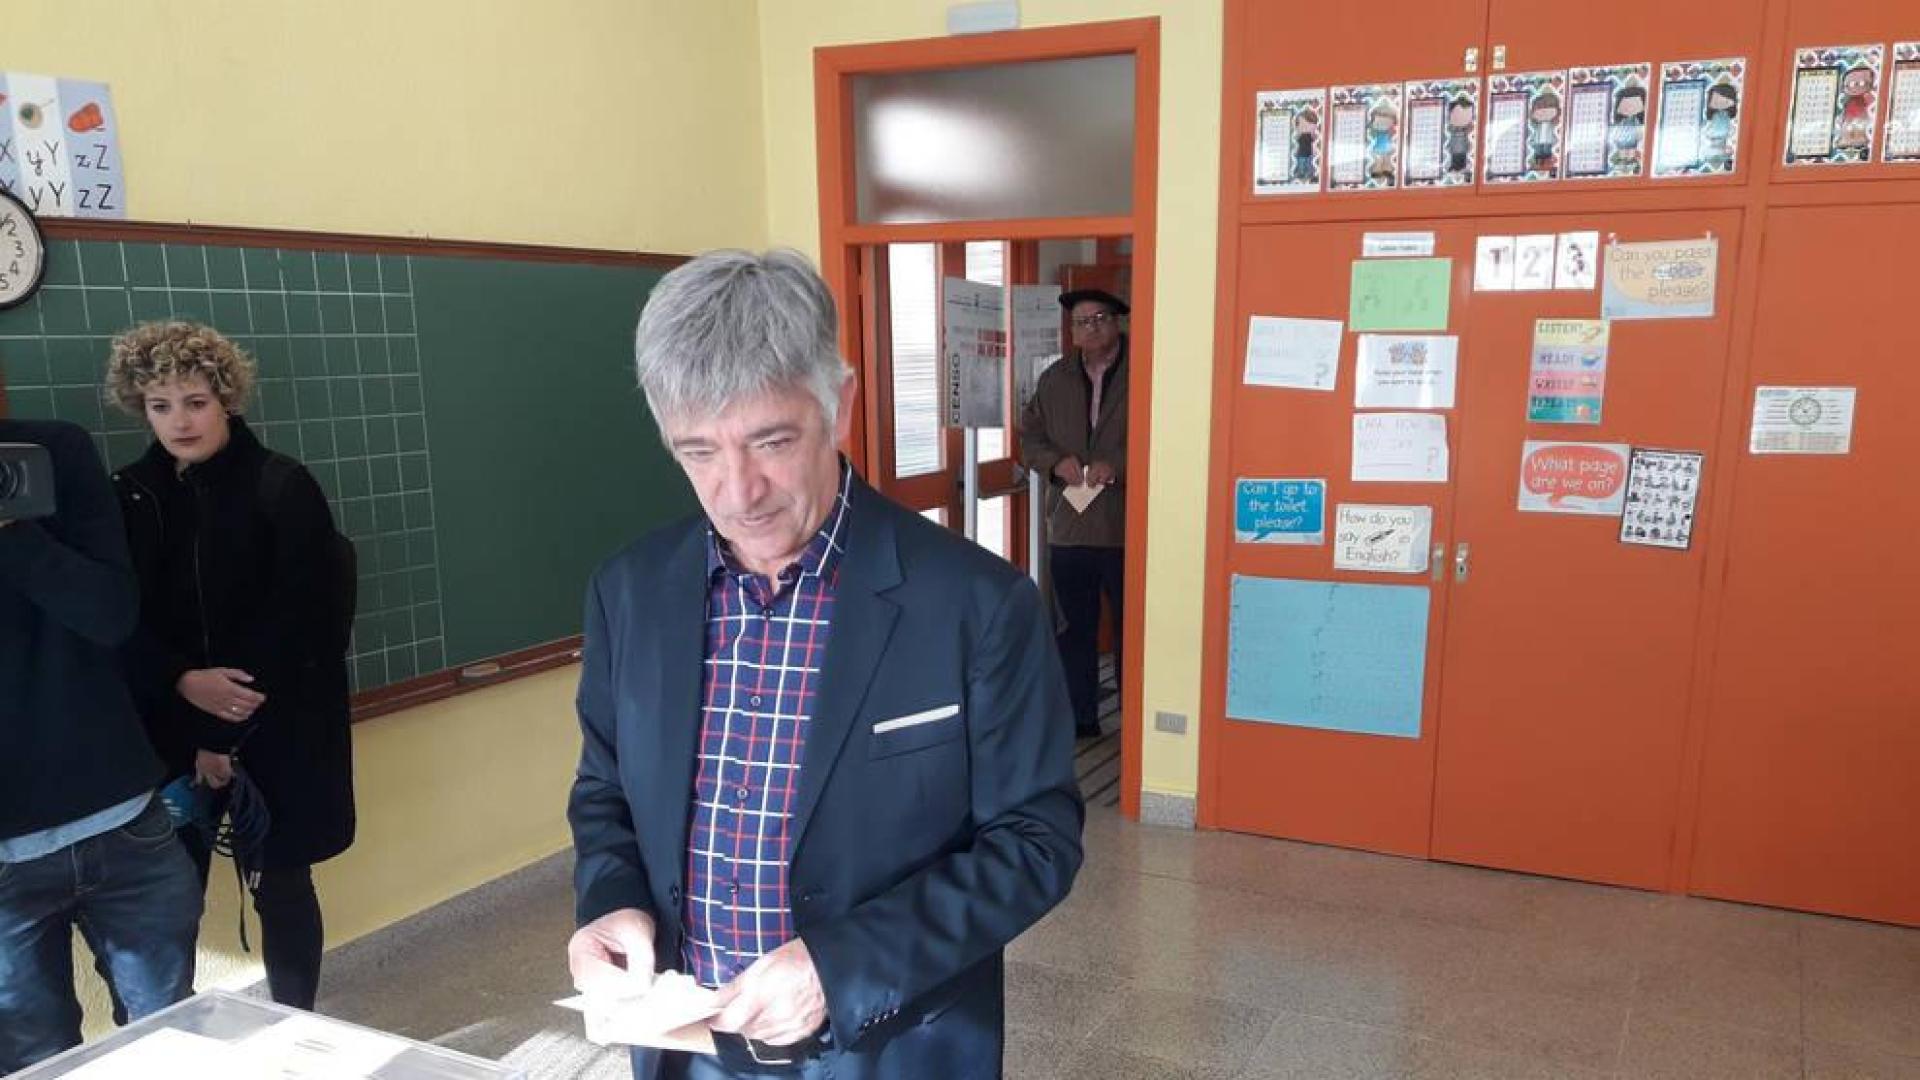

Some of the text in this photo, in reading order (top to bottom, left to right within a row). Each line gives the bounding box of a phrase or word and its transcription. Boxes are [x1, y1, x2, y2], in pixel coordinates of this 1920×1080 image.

[15, 240, 25, 258] 3
[1610, 246, 1712, 265] Can you pass
[9, 260, 19, 275] 4
[1521, 245, 1541, 278] 2
[1620, 264, 1647, 280] the
[1531, 454, 1619, 478] What page
[1242, 482, 1318, 499] Can I go to
[1531, 476, 1614, 492] are we on?
[1249, 499, 1307, 513] the toilet
[1254, 515, 1304, 530] please?
[1339, 511, 1412, 530] How do you
[1338, 531, 1360, 546] say
[1345, 546, 1401, 564] English?
